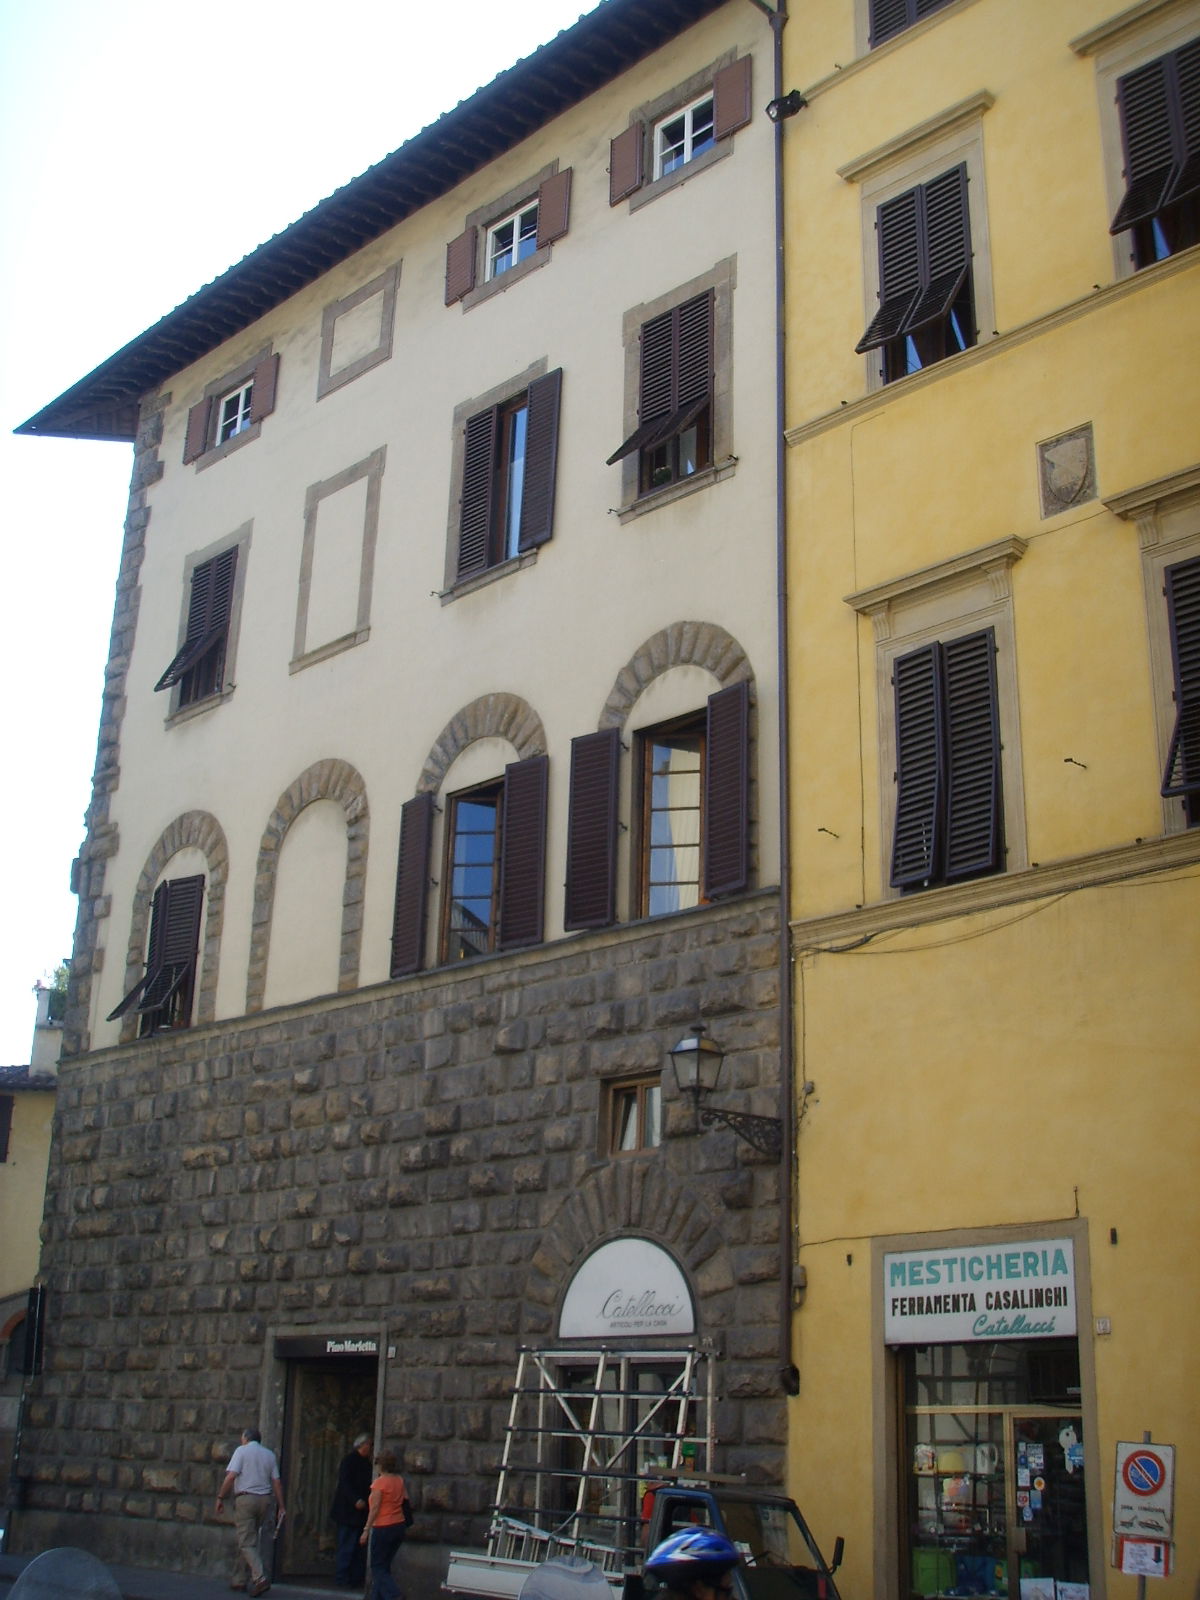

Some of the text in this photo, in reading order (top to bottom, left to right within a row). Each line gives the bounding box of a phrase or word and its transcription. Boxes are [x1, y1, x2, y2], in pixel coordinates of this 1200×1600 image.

[890, 1248, 1068, 1287] MESTICHERIA
[892, 1286, 1068, 1317] FERRAMENTA CASALINGHI
[973, 1314, 1056, 1337] Catellacci
